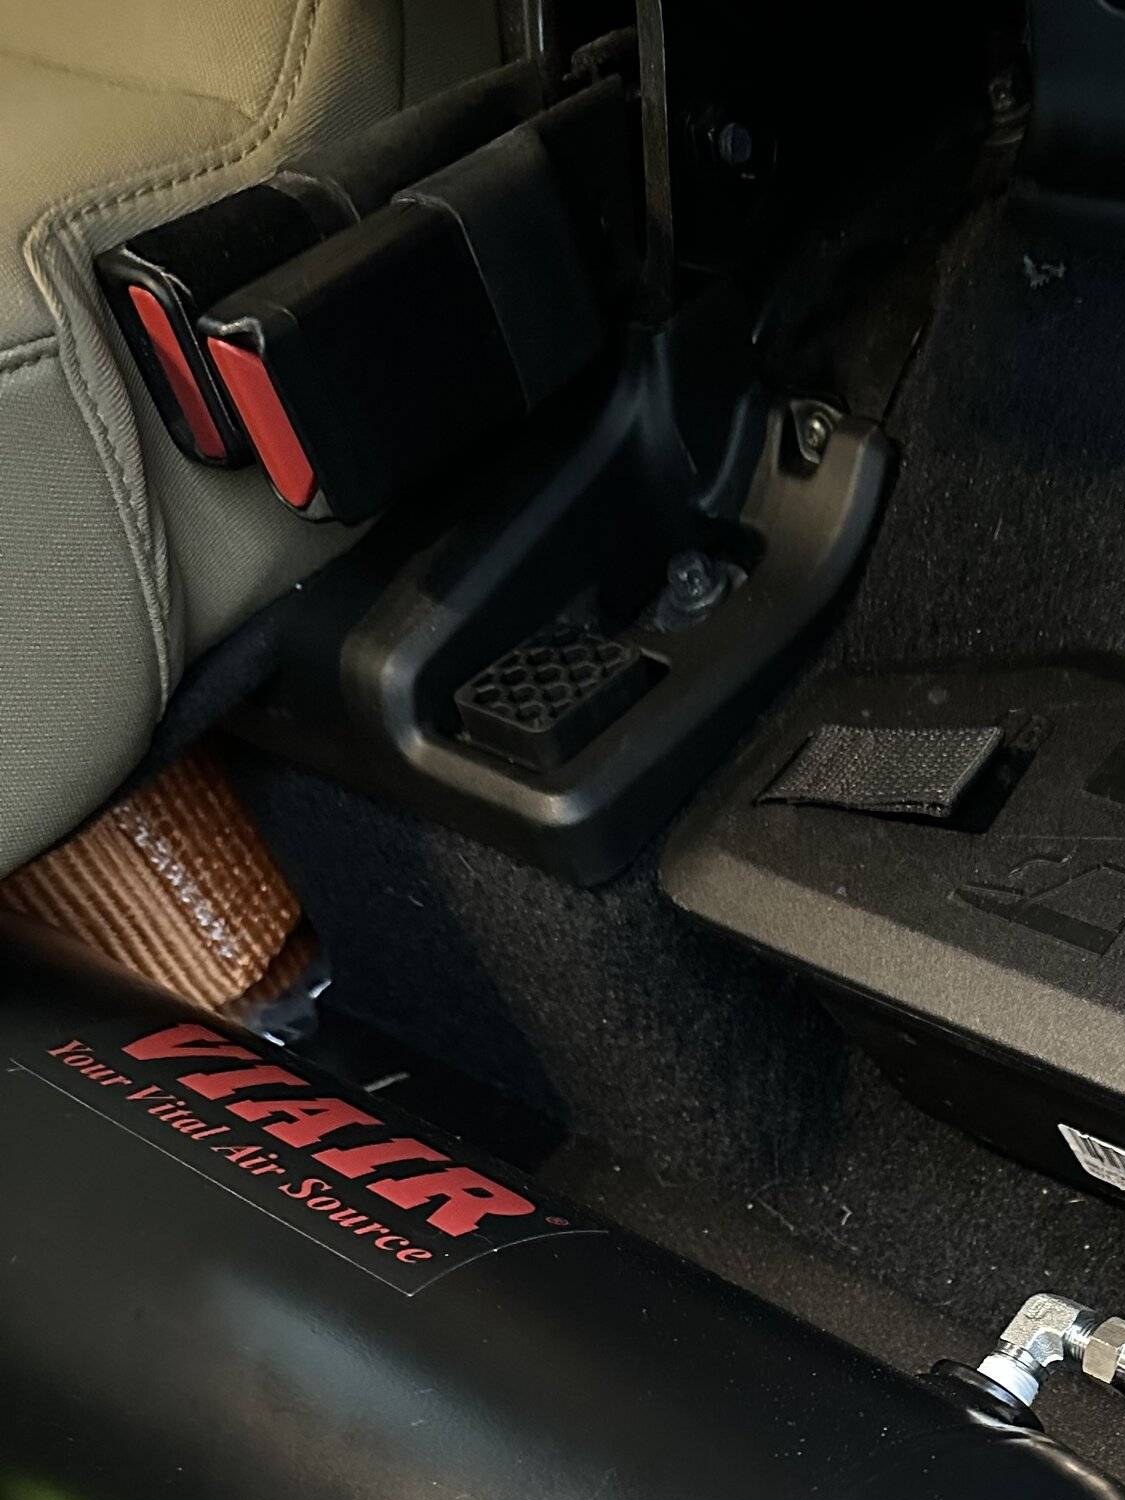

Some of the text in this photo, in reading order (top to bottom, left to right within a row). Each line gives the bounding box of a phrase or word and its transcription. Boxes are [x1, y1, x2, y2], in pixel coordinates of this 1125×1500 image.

[46, 1039, 433, 1264] Your Vital Air Source
[121, 1023, 536, 1237] VIAIR
